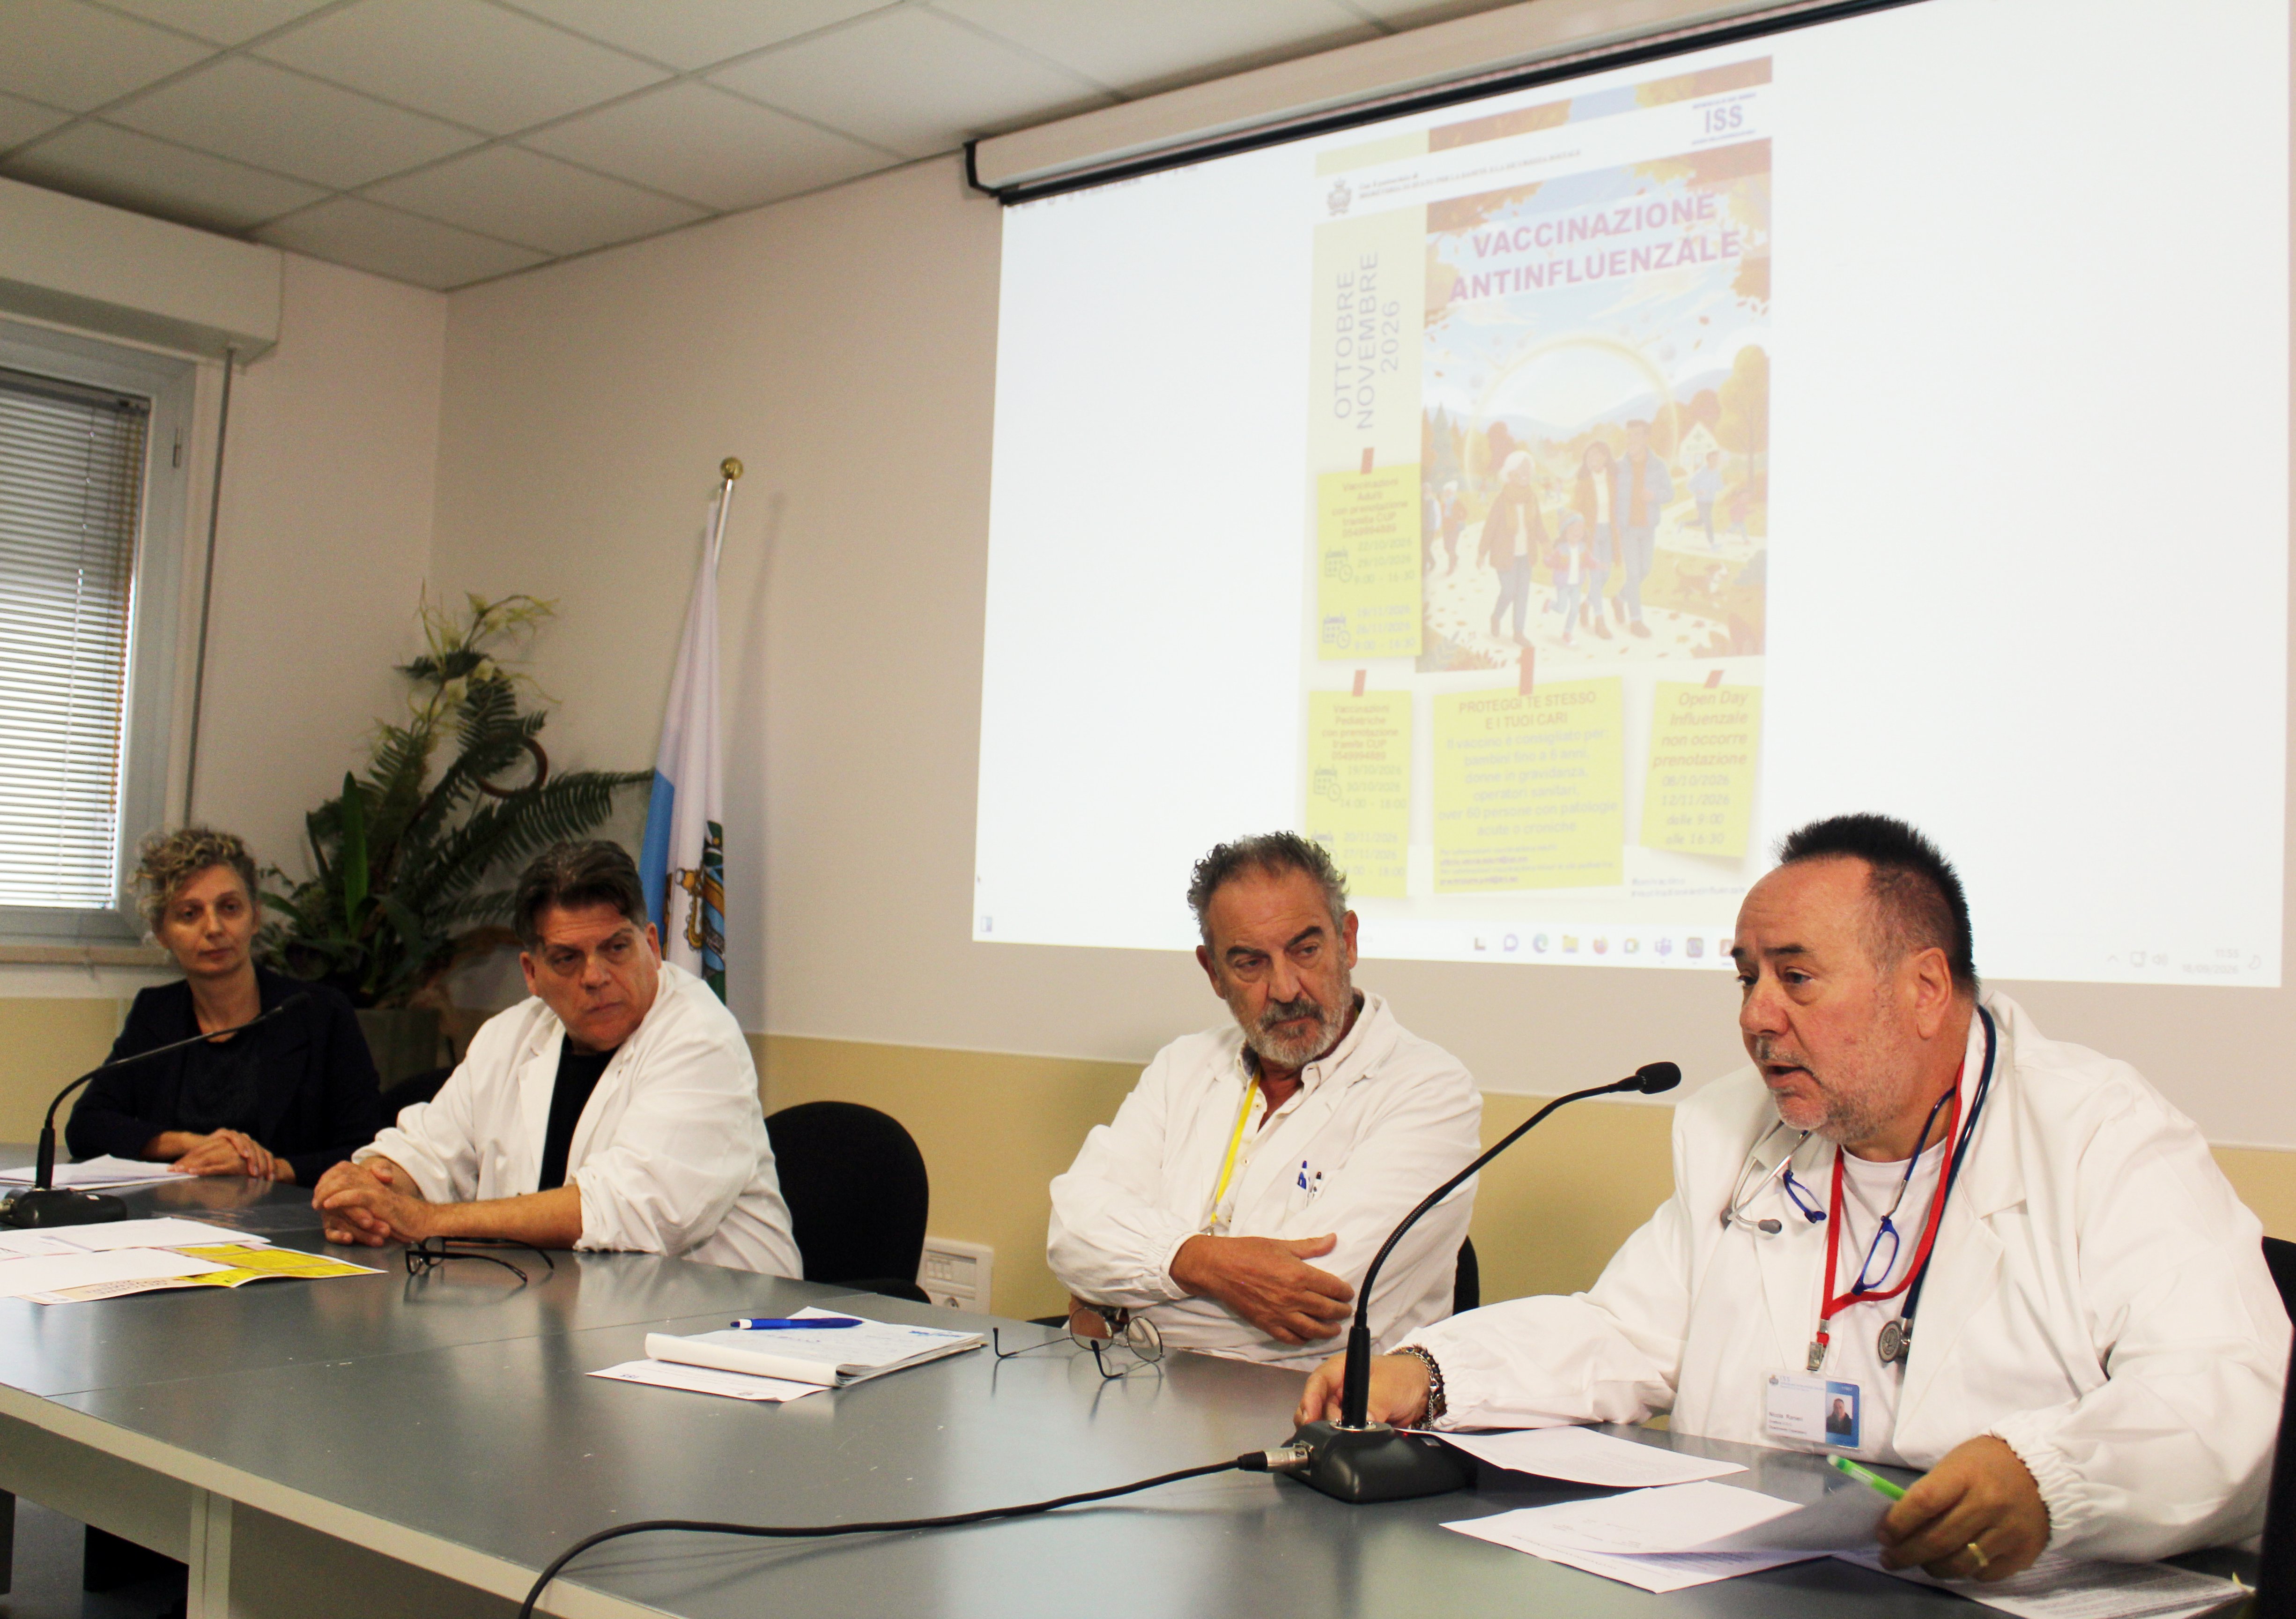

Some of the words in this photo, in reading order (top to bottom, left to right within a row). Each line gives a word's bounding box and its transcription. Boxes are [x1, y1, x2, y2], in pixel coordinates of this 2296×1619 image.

[1705, 104, 1743, 133] ISS
[1472, 193, 1716, 258] VACCINAZIONE
[1448, 230, 1740, 302] ANTINFLUENZALE
[1334, 270, 1354, 418] OTTOBRE
[1357, 252, 1378, 430] NOVEMBRE
[1380, 300, 1400, 373] 2026
[1459, 697, 1522, 714] PROTEGGI
[1526, 696, 1541, 709] TE
[1545, 691, 1596, 707] STESSO
[1679, 692, 1716, 708] Open
[1720, 691, 1748, 707] Day
[1485, 718, 1493, 730] E
[1504, 714, 1533, 728] TUOI
[1537, 712, 1568, 726] CARI
[1670, 710, 1748, 726] Influenzale
[1456, 737, 1501, 749] vaccino
[1516, 728, 1581, 747] consigliato
[1662, 736, 1687, 746] non
[1691, 734, 1748, 745] occorre
[1464, 752, 1511, 767] bambini
[1652, 752, 1748, 770] prenotazione
[1465, 772, 1501, 784] donne
[1505, 771, 1515, 781] in
[1474, 787, 1527, 802] operatori
[1438, 809, 1464, 820] over
[1483, 806, 1532, 820] persone
[1535, 804, 1557, 816] con
[1561, 800, 1618, 816] patologie
[1477, 824, 1510, 836] acute
[1523, 821, 1577, 834] croniche
